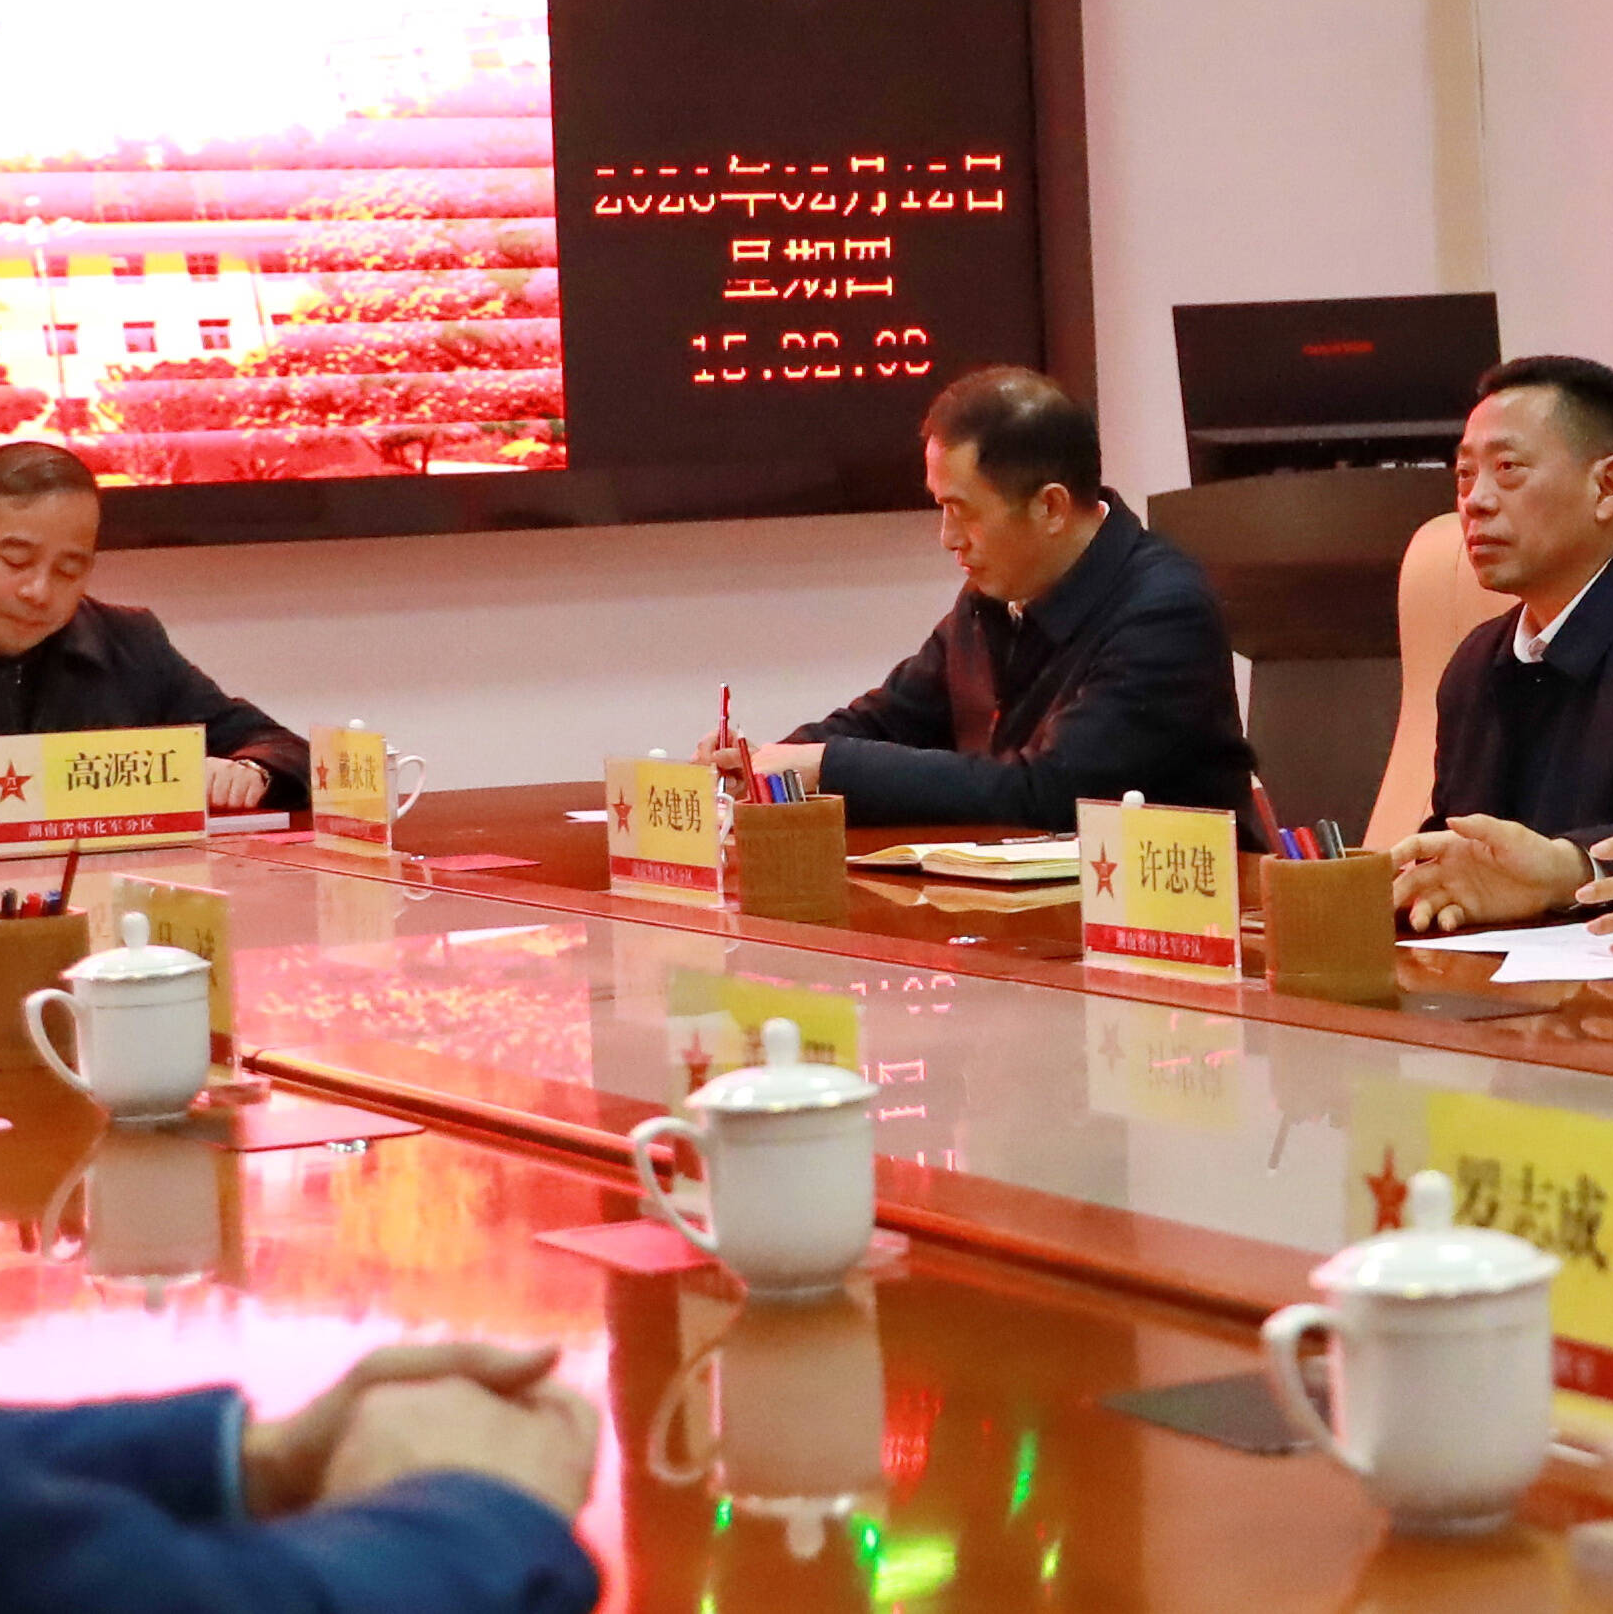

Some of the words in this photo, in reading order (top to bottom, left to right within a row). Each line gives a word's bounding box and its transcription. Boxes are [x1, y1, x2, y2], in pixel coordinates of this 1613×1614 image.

[65, 749, 181, 791] 高源江
[28, 817, 155, 838] 湖南省怀化军分区
[647, 784, 702, 834] 余建勇
[1139, 839, 1217, 898] 许忠建
